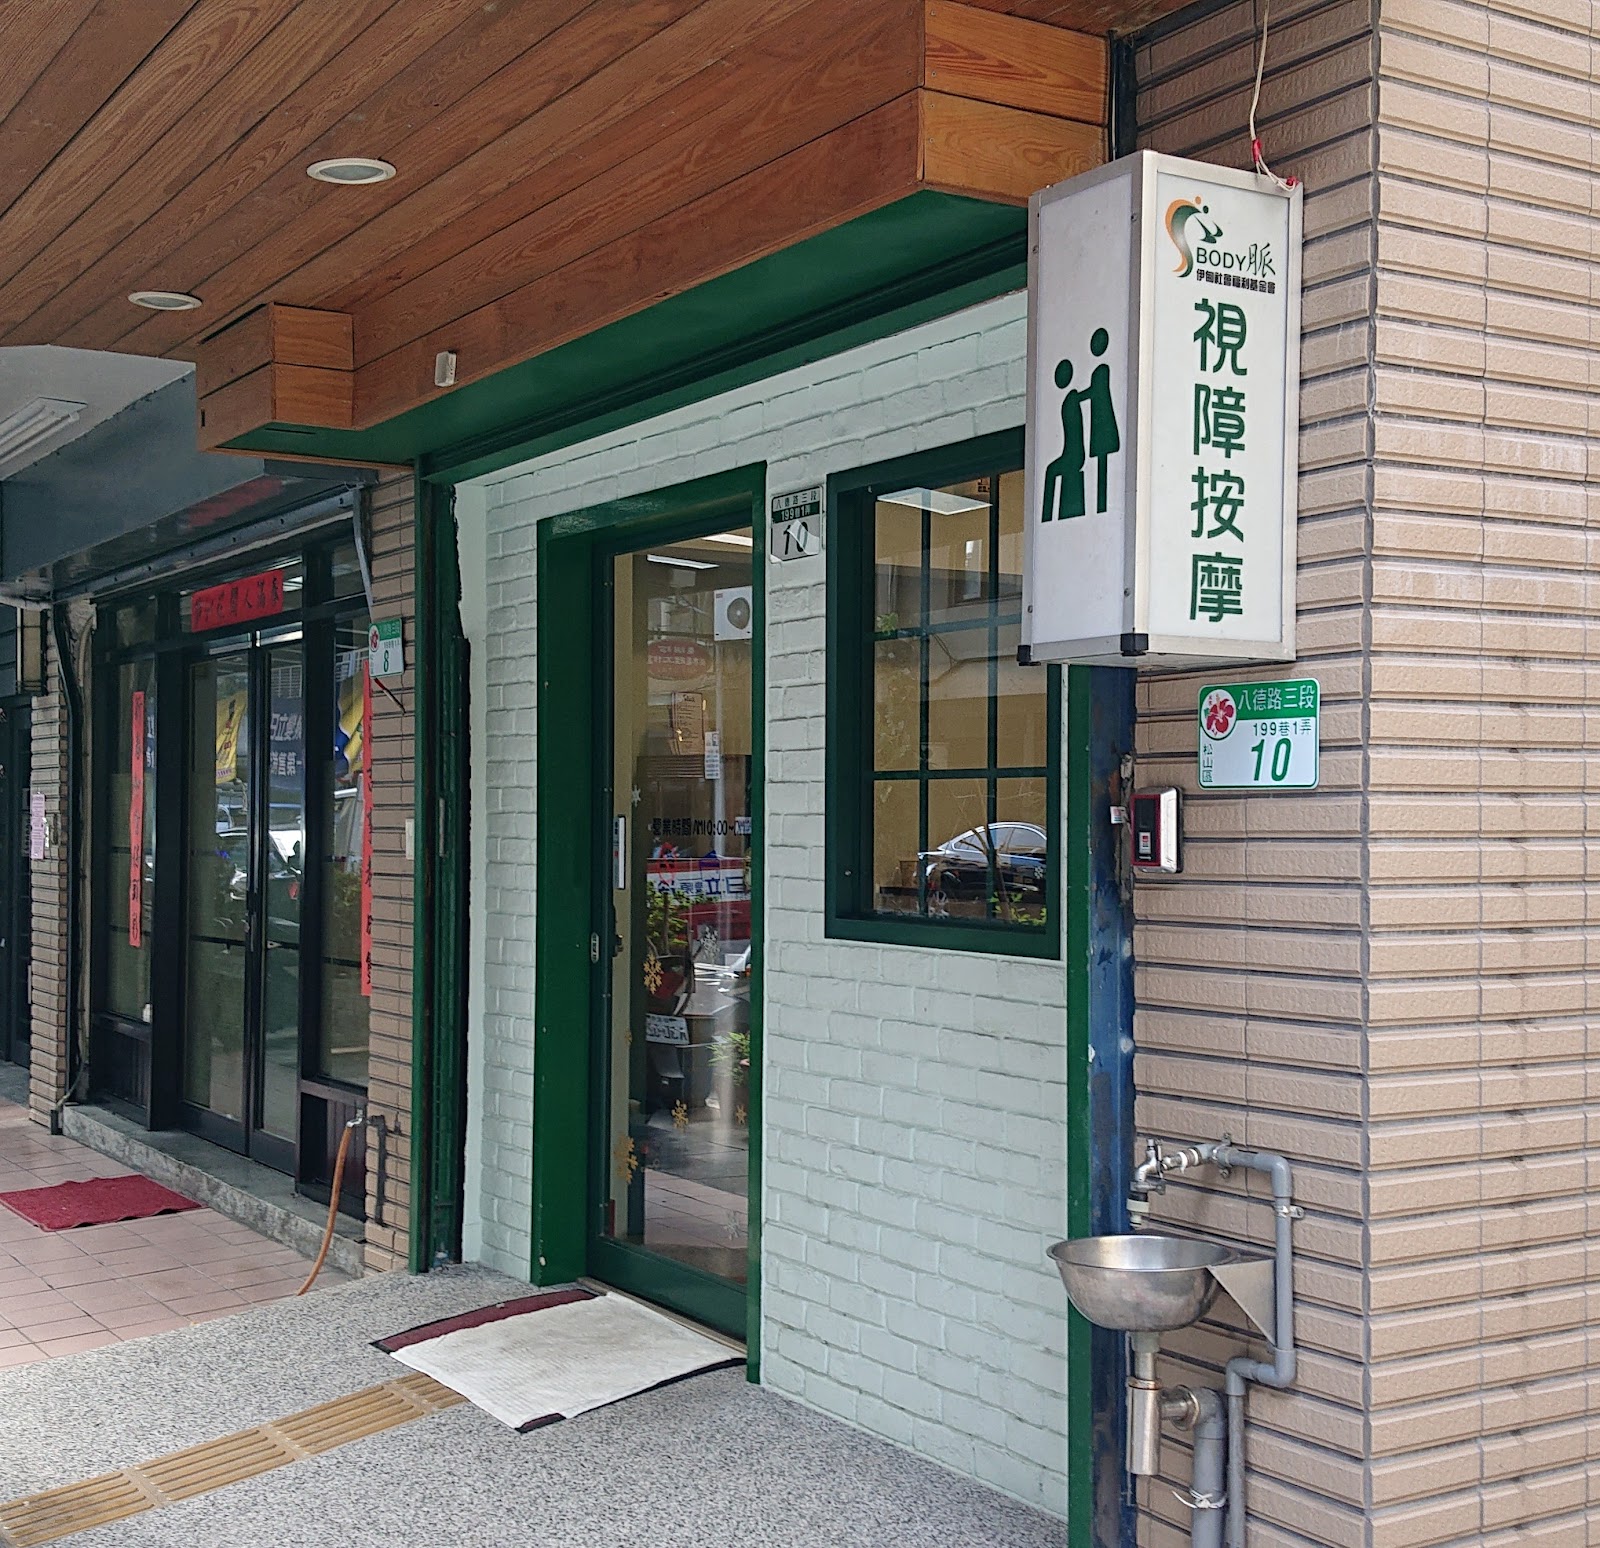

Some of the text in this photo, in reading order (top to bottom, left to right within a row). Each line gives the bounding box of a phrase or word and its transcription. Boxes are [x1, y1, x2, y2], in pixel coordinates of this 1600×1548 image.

[1196, 268, 1276, 294] 伊甸社會福利基金會
[1190, 297, 1248, 623] 視障按摩
[383, 649, 390, 673] 8
[1237, 684, 1316, 712] 八德路三段
[1253, 718, 1312, 737] 199巷1弄
[1251, 737, 1292, 782] 10
